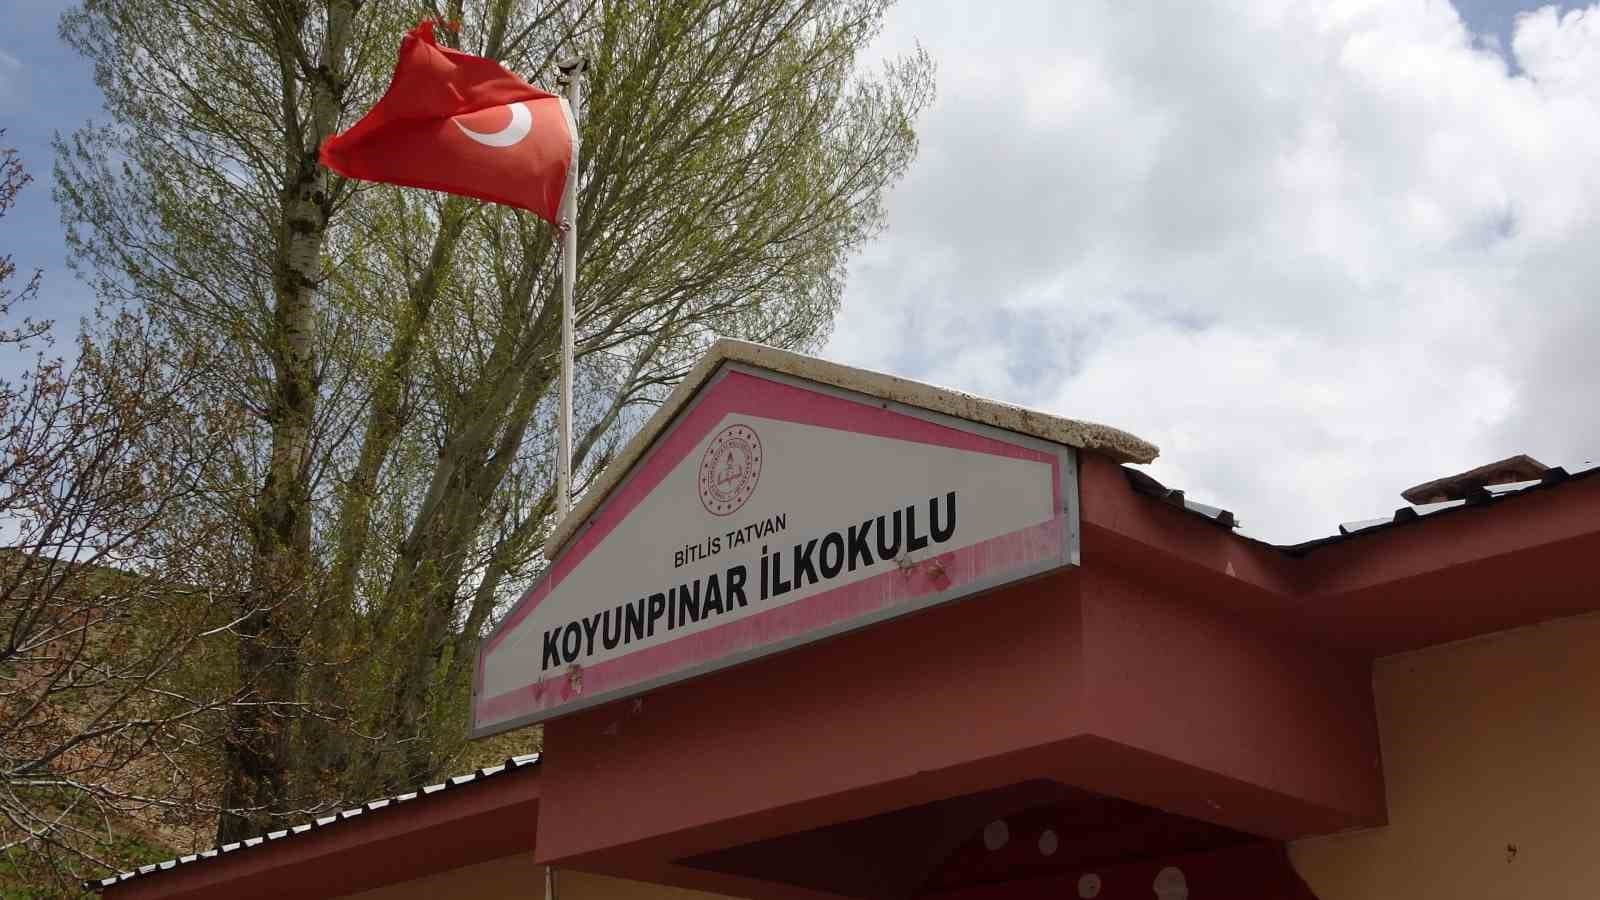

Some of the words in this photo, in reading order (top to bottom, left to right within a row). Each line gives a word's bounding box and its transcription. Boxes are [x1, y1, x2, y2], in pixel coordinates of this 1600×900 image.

[541, 564, 748, 671] KOYUNPINAR
[759, 491, 957, 600] İLKOKULU
[674, 536, 721, 568] BİTLİS
[725, 513, 787, 550] TATVAN
